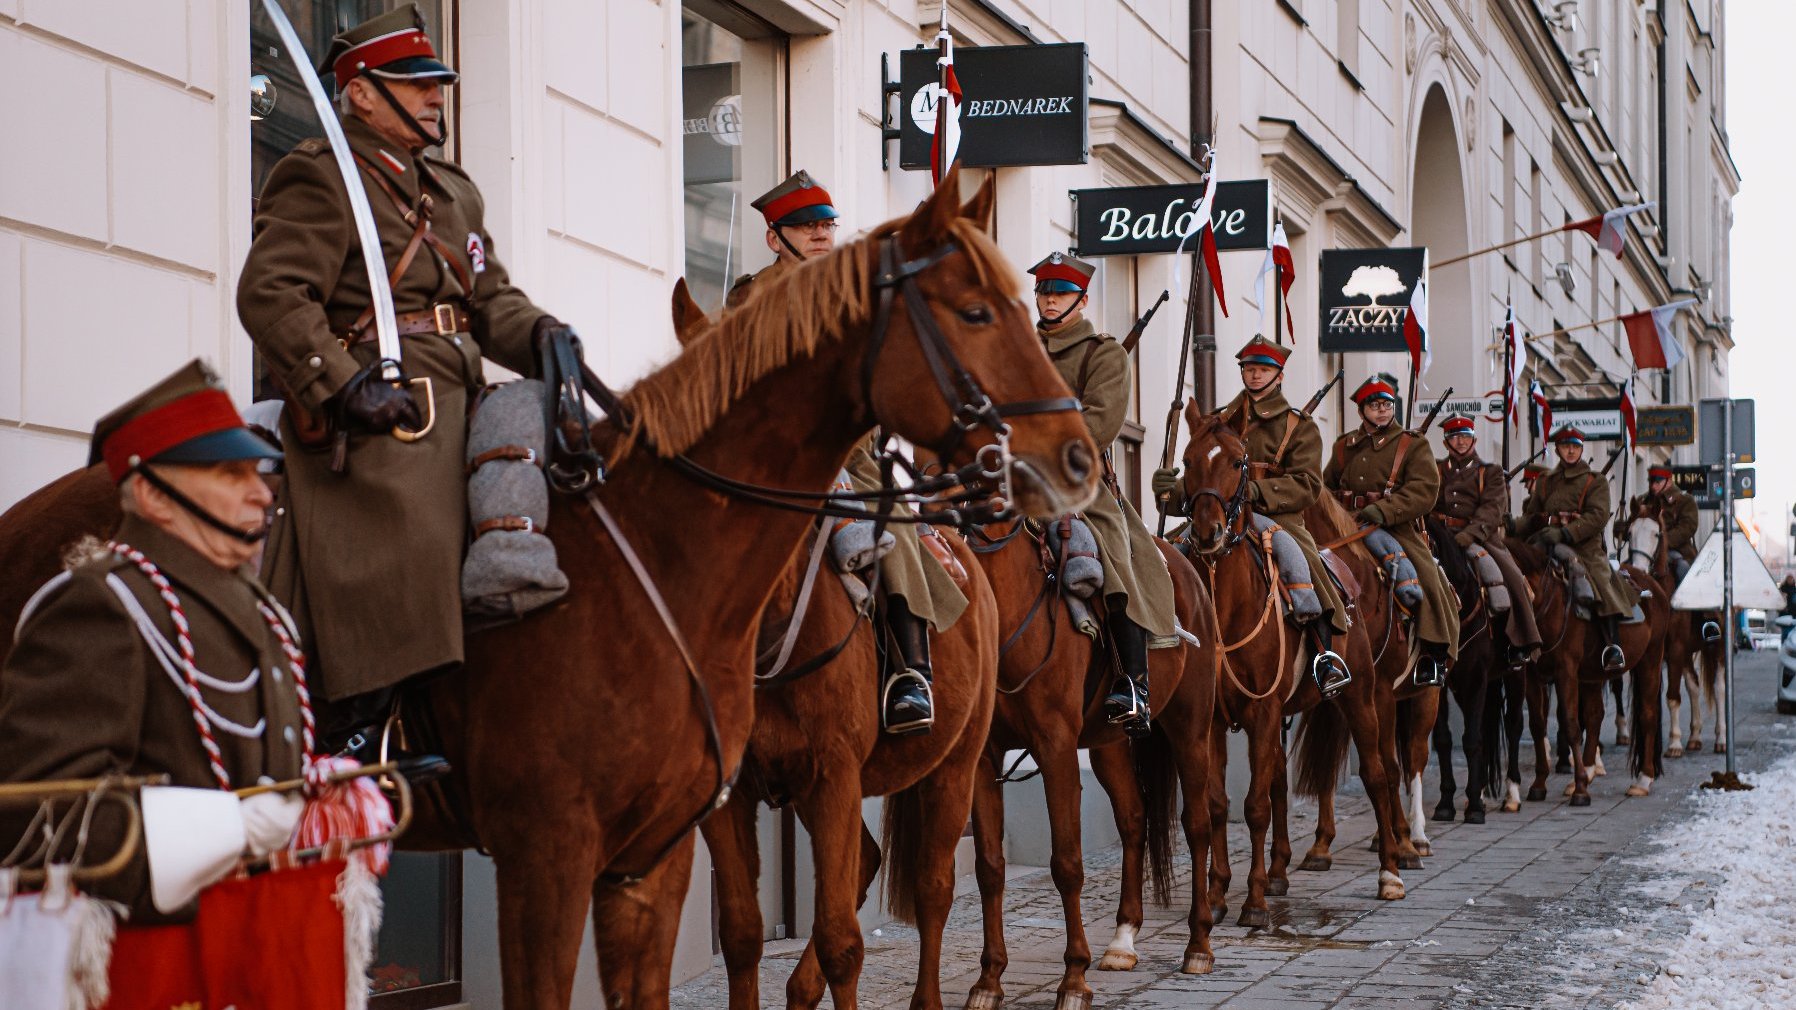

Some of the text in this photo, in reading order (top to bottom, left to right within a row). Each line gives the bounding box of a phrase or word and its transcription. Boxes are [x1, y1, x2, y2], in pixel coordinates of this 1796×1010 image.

[967, 97, 1074, 117] BEDNAREK
[1329, 308, 1408, 327] ZACZY
[1446, 401, 1482, 413] SAMOCHÓD
